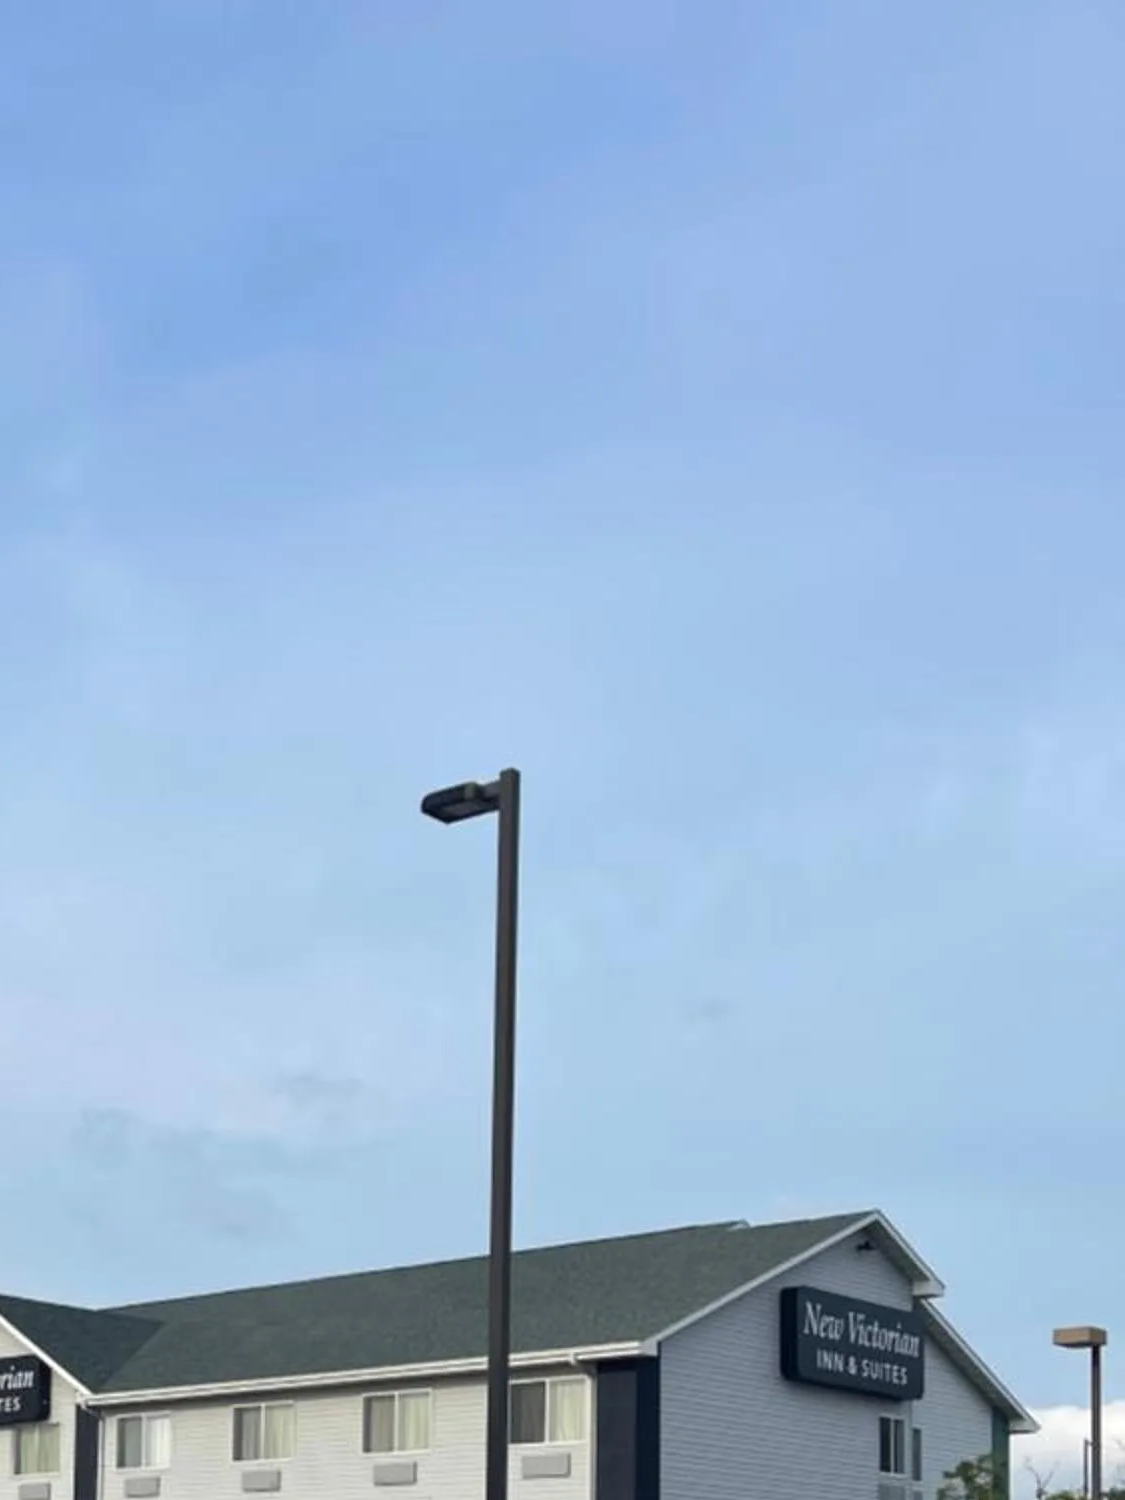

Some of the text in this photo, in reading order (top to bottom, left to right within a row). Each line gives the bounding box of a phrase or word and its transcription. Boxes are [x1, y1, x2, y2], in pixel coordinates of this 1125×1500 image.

[803, 1301, 920, 1358] New Victorian
[816, 1349, 908, 1385] INN & SUITES
